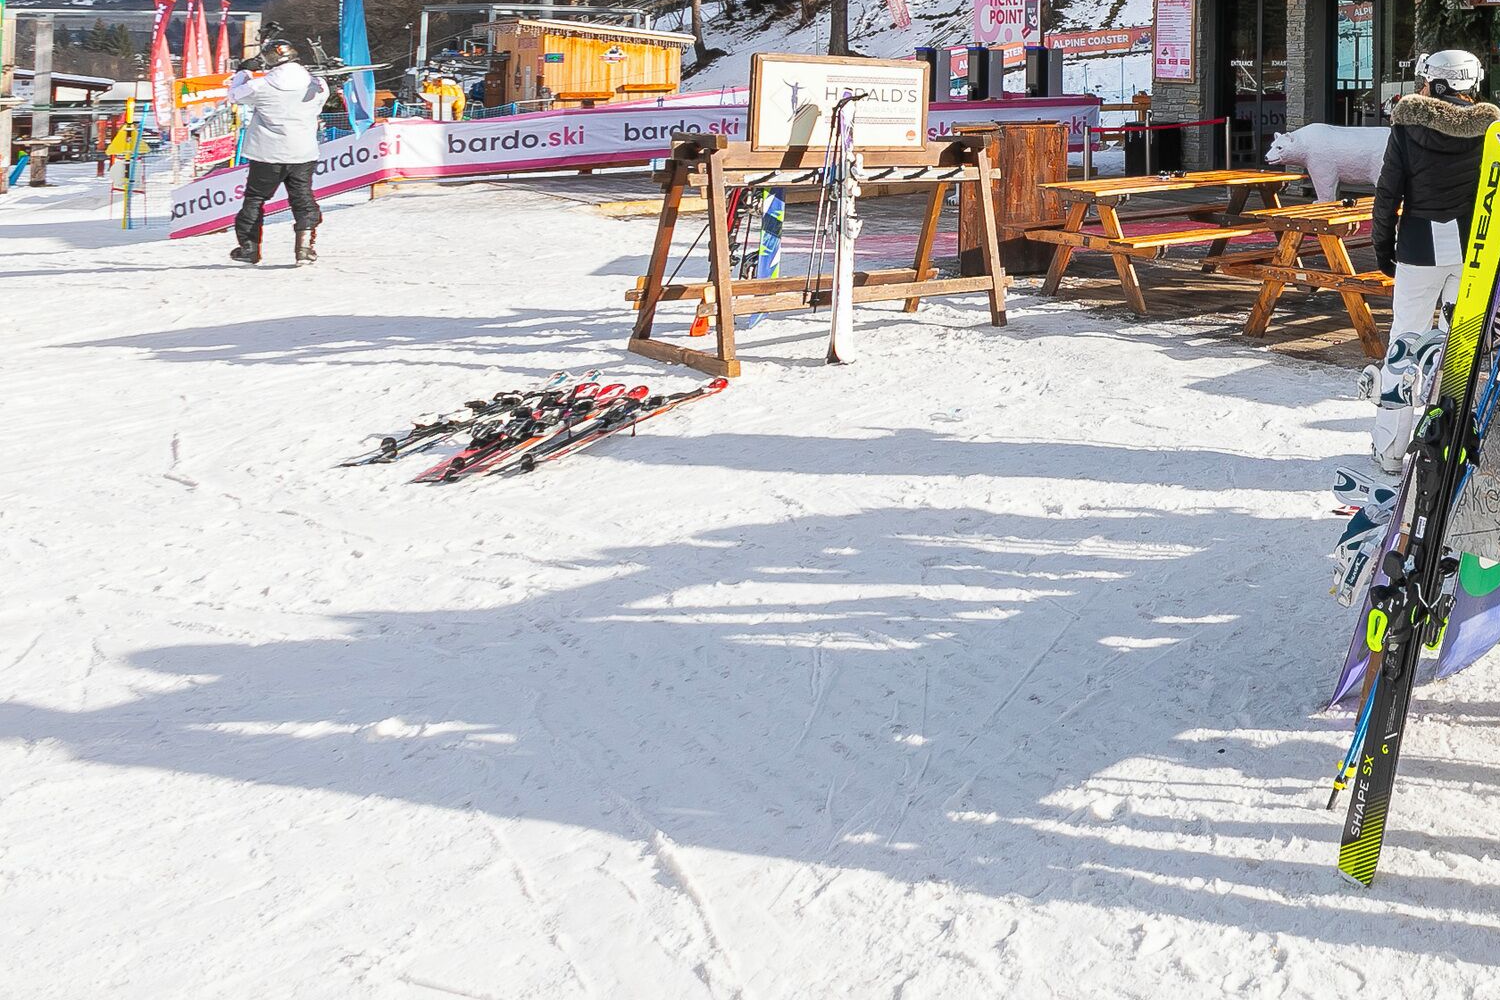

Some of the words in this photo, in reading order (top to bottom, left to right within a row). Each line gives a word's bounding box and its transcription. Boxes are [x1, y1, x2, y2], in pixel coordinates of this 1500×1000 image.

[989, 8, 1024, 25] POINT
[1003, 46, 1024, 59] STER
[1053, 37, 1086, 50] ALPINE
[1087, 33, 1129, 47] COASTER
[825, 86, 918, 103] HRALD'S
[447, 124, 585, 154] bardo.ski
[624, 116, 740, 141] bardoski
[312, 134, 401, 176] ardo.si
[170, 182, 246, 222] ardo.s
[1351, 779, 1370, 838] SHAPE
[1362, 754, 1375, 777] SX
